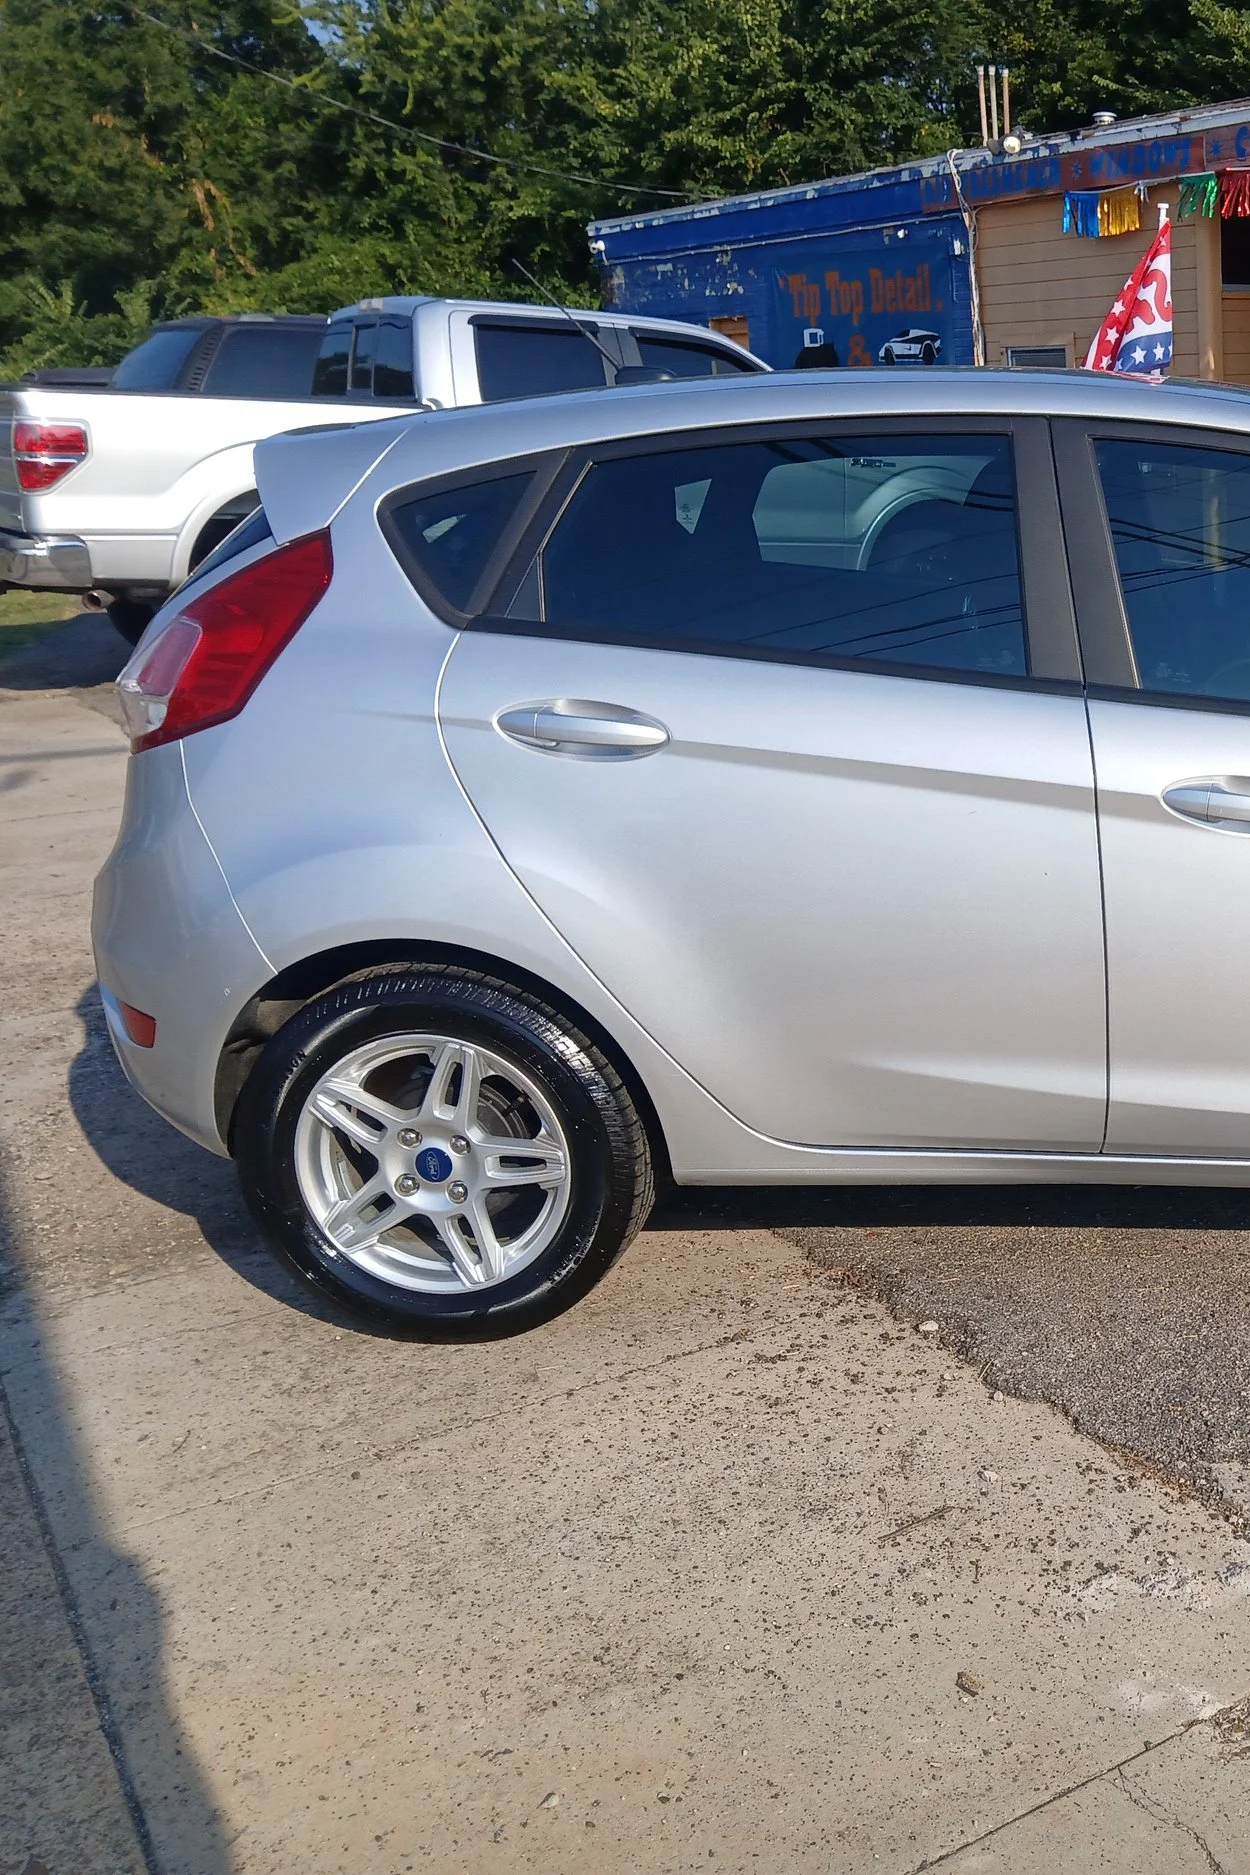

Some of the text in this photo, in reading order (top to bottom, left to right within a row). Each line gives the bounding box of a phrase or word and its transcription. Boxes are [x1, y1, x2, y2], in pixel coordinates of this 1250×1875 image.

[788, 273, 821, 328] Tip
[825, 271, 864, 327] Top
[848, 334, 873, 366] &
